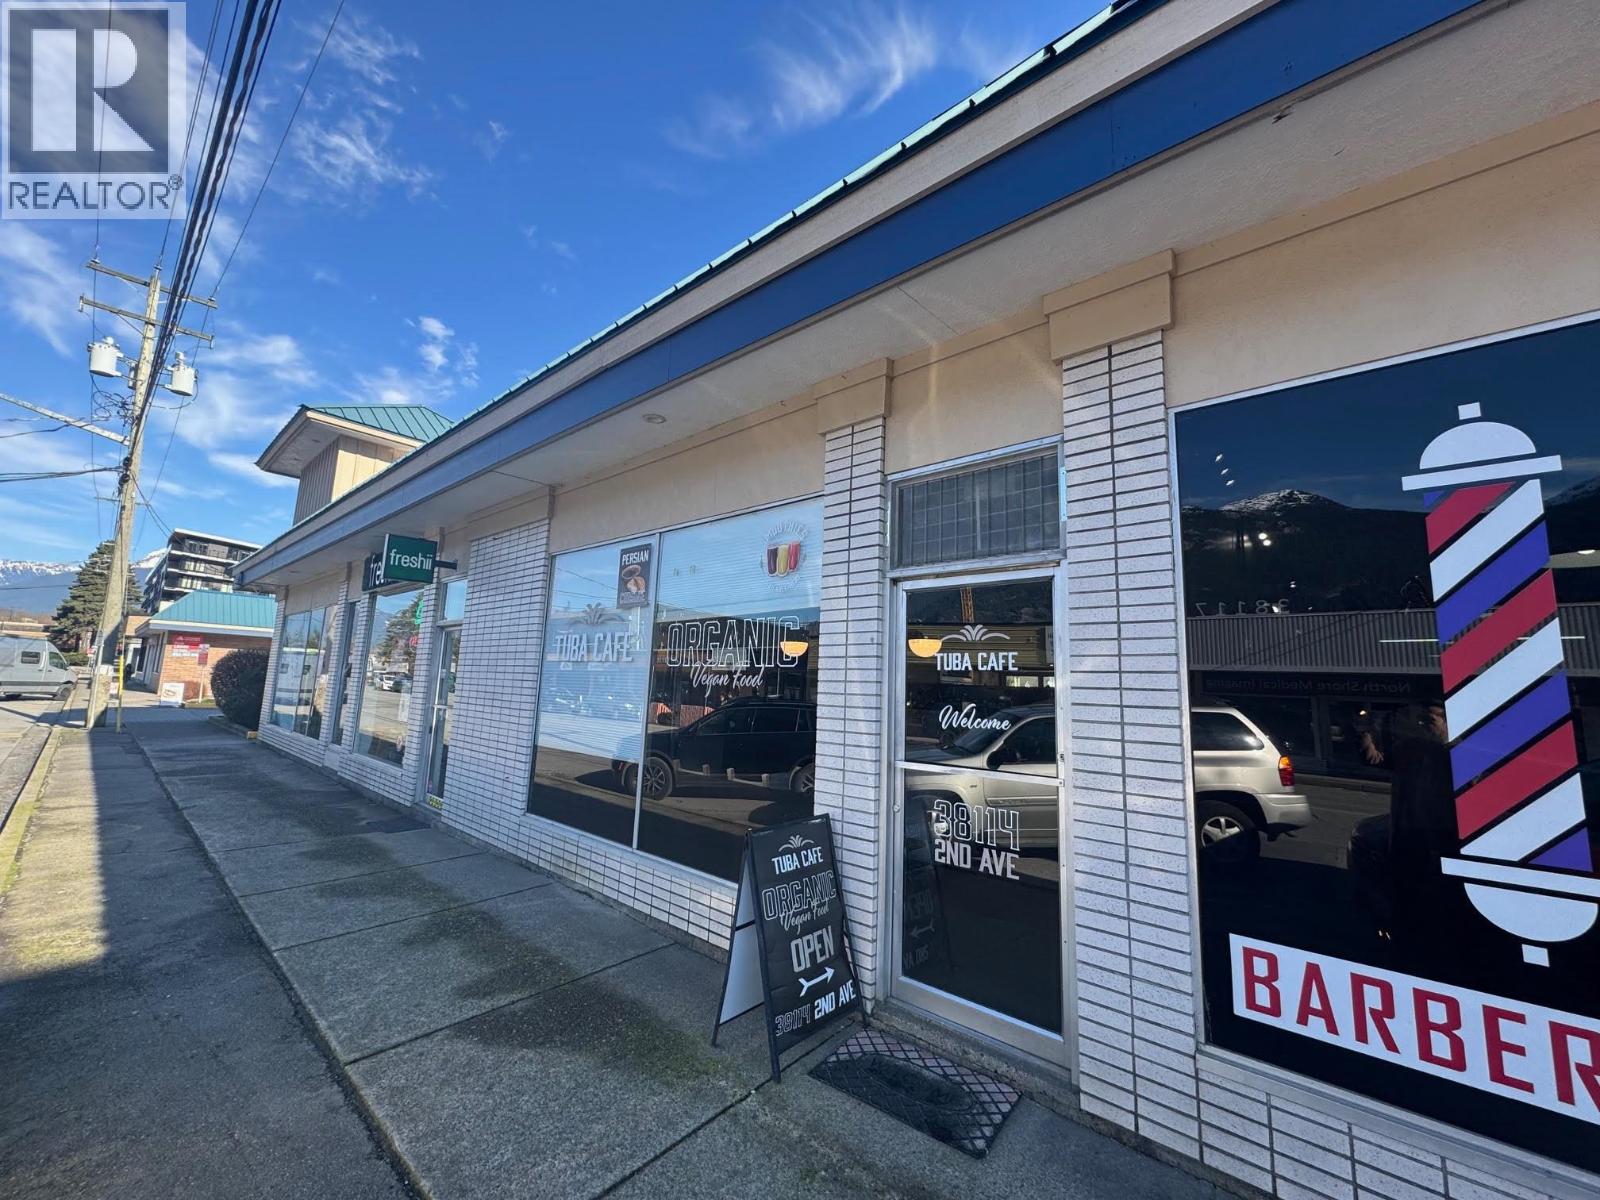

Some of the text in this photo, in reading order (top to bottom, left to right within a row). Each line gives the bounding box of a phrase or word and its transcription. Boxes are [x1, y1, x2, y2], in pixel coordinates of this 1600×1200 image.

[389, 549, 433, 570] freshii
[622, 549, 649, 566] PERSIAN
[555, 630, 634, 662] TUBA CAFE
[666, 615, 800, 668] ORGANIC
[690, 660, 764, 698] Vegan Food
[935, 651, 1018, 672] TUBA CAFE
[938, 703, 1012, 731] Welcome
[933, 799, 1020, 851] 38114
[772, 846, 824, 875] TUBA CAFE
[934, 838, 1020, 880] 2ND AVE
[762, 869, 837, 921] ORGANIC
[780, 909, 812, 935] Vegan
[790, 925, 836, 973] OPEN
[775, 979, 857, 1037] 38114 2ND AVE
[1242, 946, 1600, 1114] BARBER
